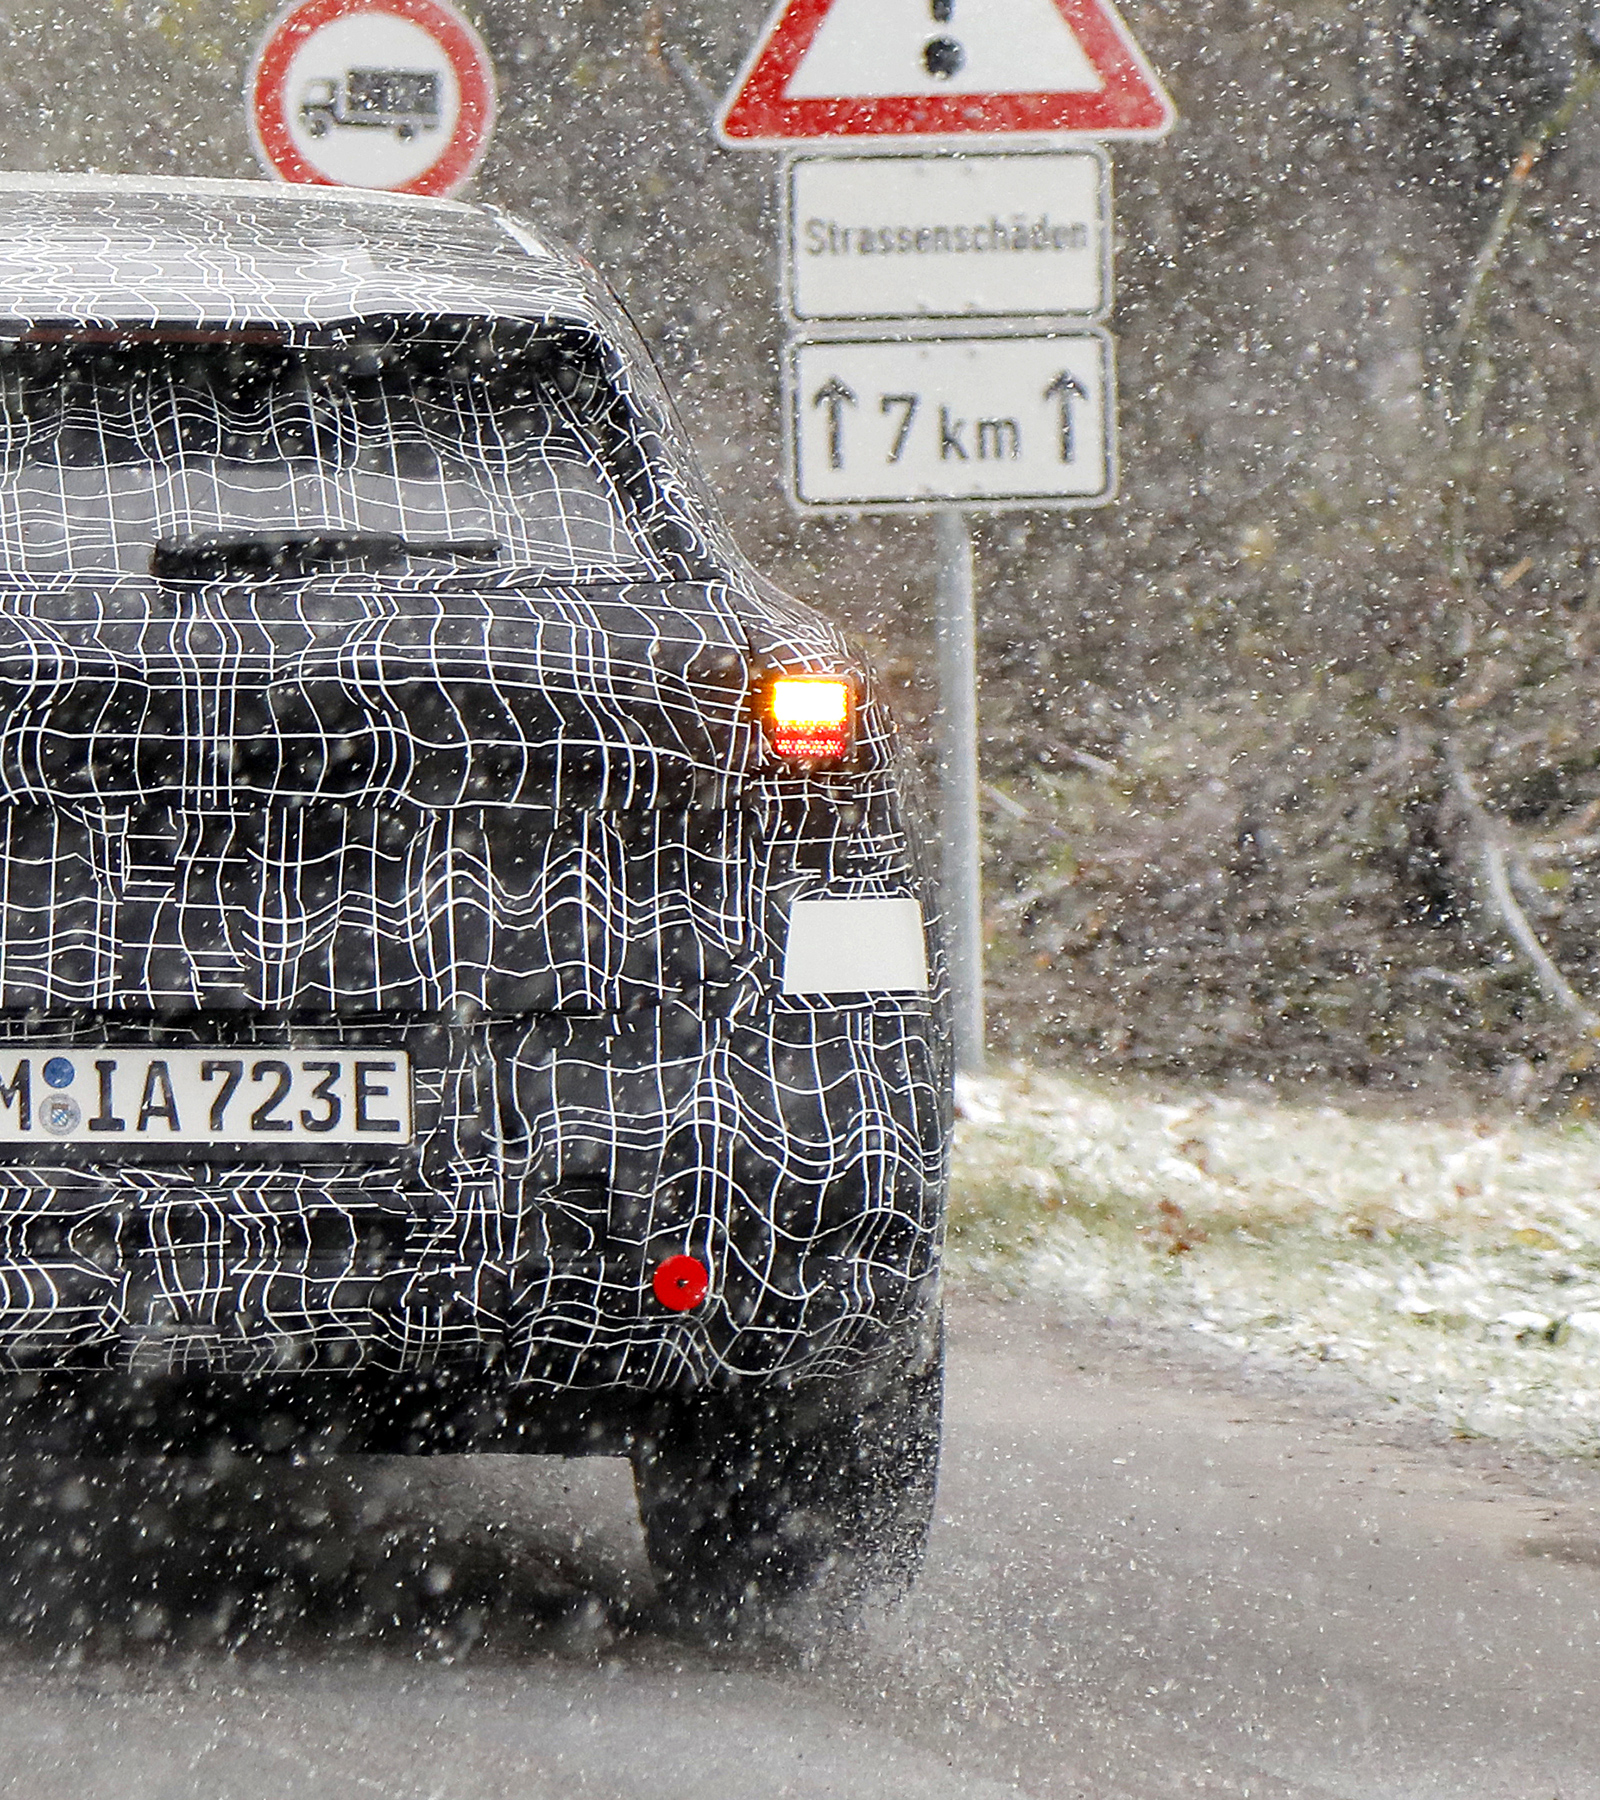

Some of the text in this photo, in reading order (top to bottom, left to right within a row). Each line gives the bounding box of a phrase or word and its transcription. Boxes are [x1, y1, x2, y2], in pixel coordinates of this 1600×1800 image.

[805, 213, 1088, 256] Strassenschäden
[880, 393, 1021, 463] 7 km
